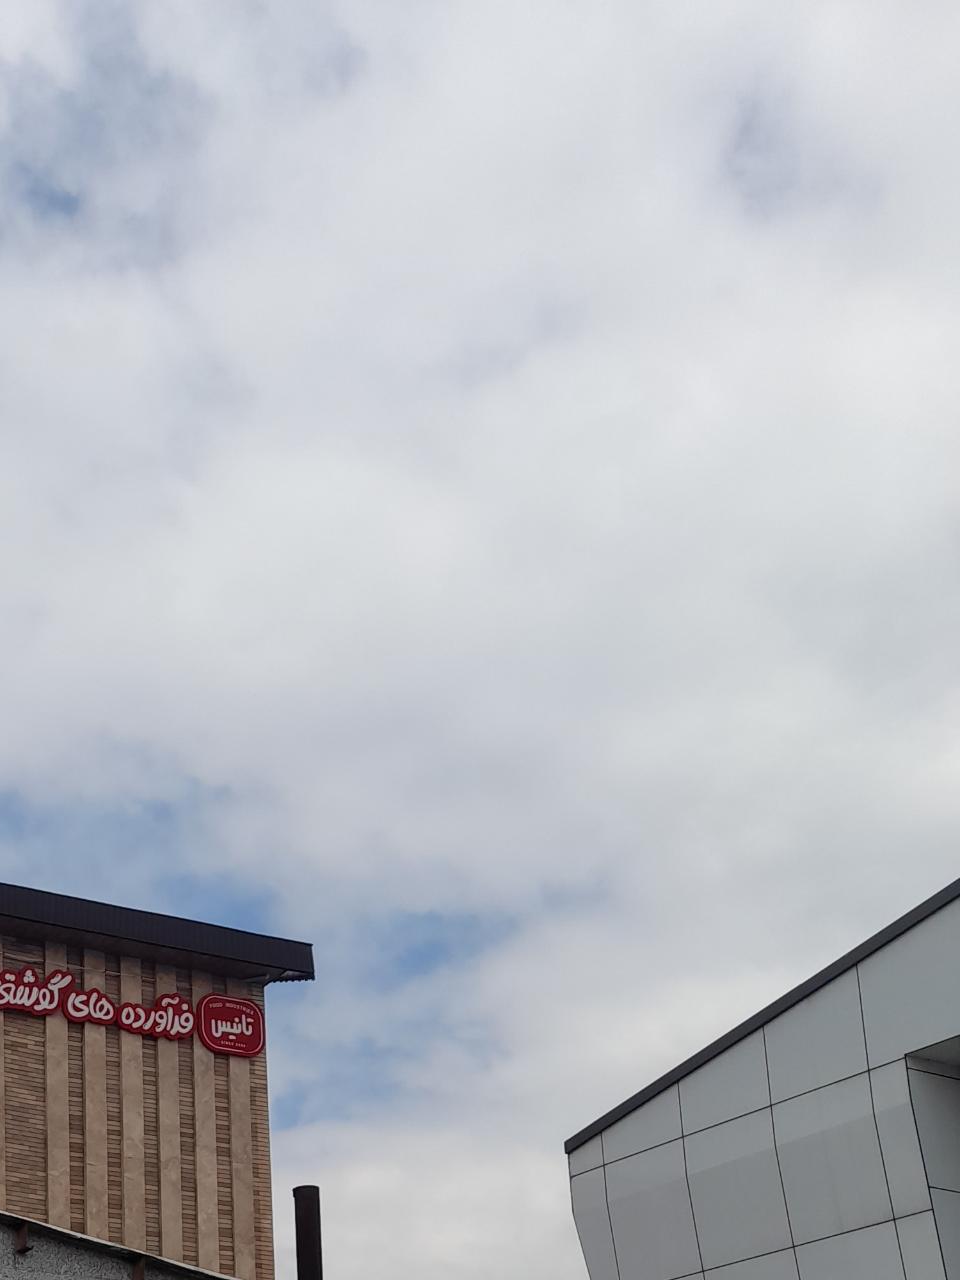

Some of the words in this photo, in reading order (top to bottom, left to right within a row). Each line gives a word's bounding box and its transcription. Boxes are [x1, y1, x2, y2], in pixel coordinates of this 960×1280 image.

[67, 992, 114, 1020] های
[121, 996, 194, 1036] فرآورده
[211, 1014, 254, 1039] تانیس
